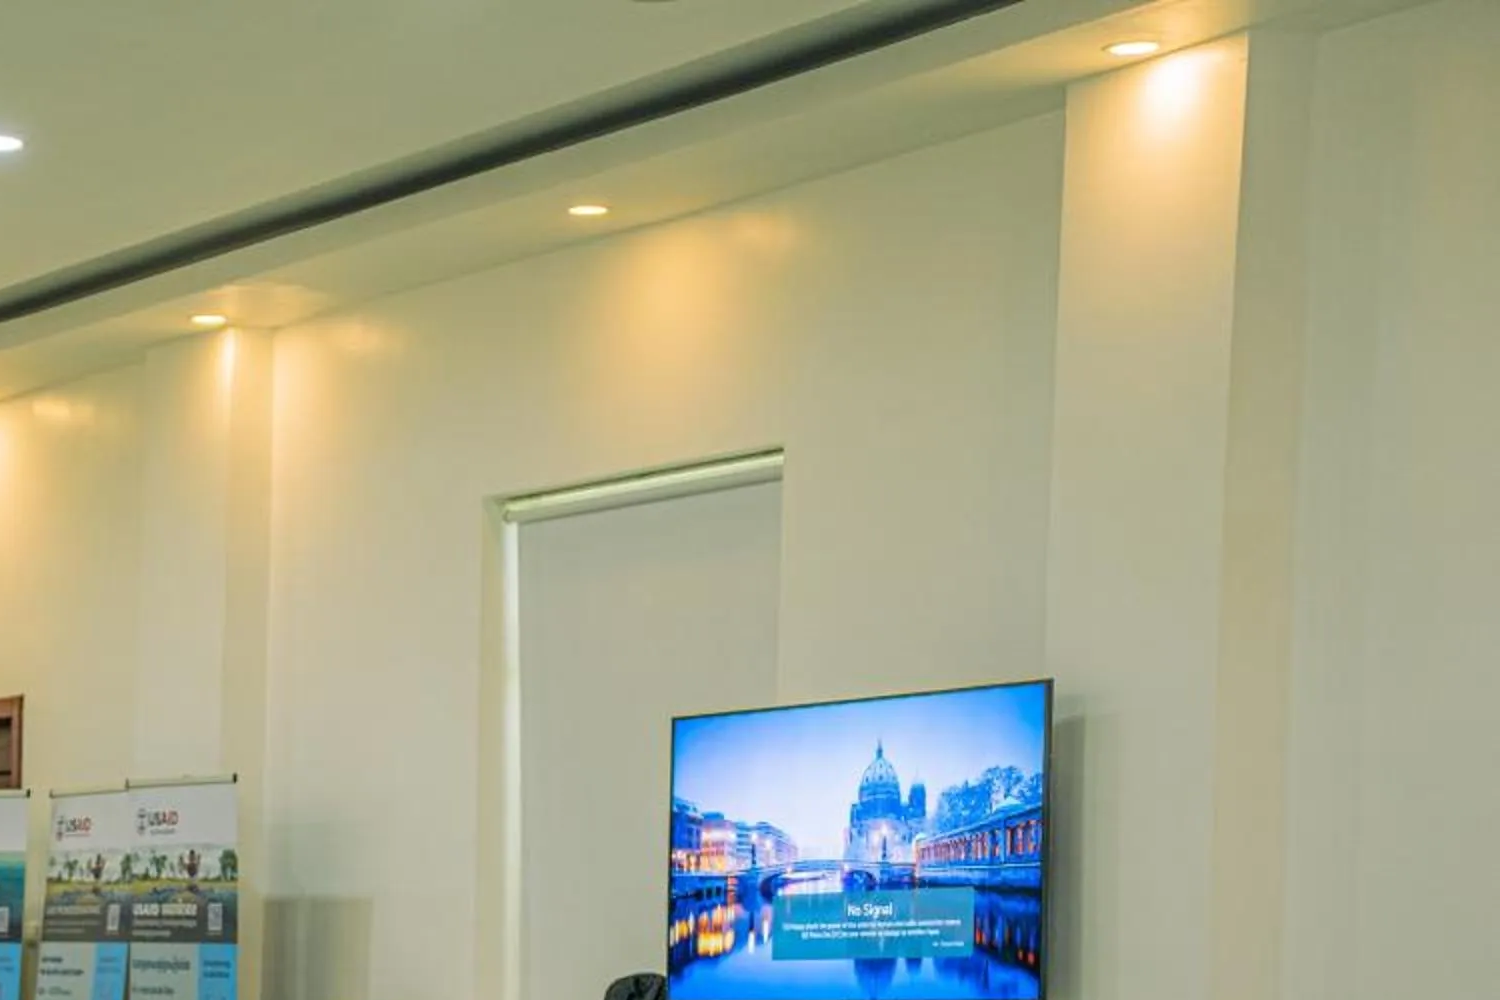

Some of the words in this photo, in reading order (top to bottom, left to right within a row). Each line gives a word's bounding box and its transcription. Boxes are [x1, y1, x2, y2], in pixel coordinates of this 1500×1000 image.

[66, 818, 91, 832] USAID
[149, 811, 179, 826] USAID
[847, 905, 861, 916] No
[863, 902, 893, 919] Signal
